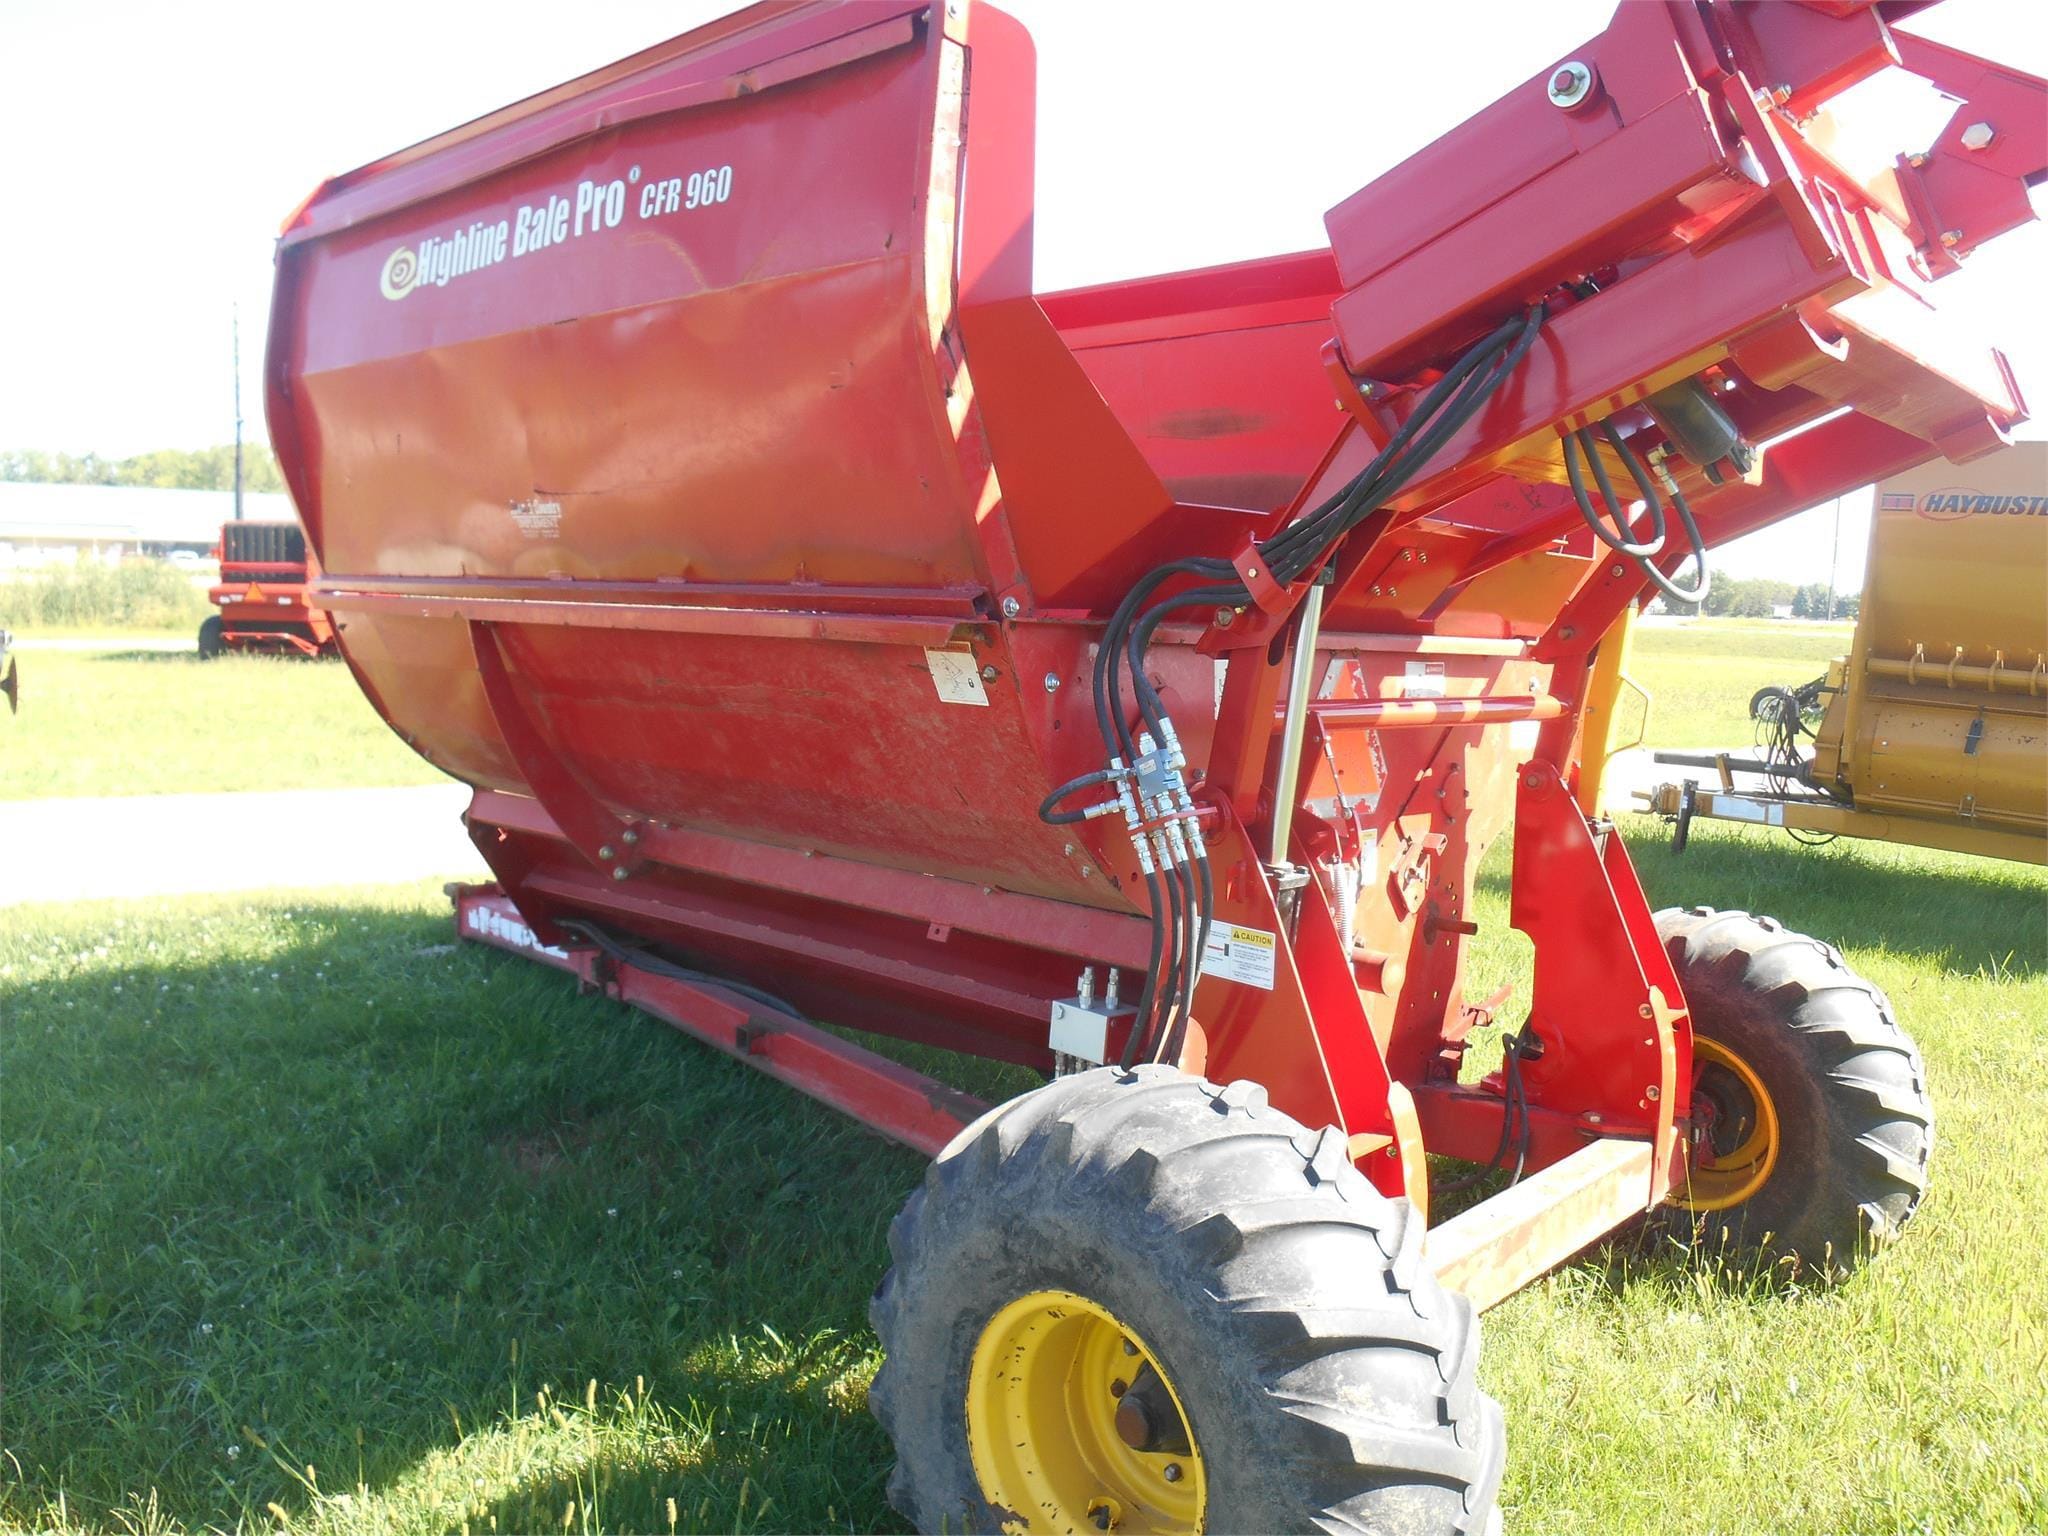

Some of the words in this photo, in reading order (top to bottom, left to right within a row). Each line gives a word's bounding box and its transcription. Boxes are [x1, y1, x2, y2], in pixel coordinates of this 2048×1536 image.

[415, 220, 509, 287] Highline
[512, 195, 570, 258] Bale
[574, 180, 626, 237] Pro
[639, 178, 682, 219] CFR
[685, 165, 733, 209] 960
[1240, 932, 1272, 945] CAUTION
